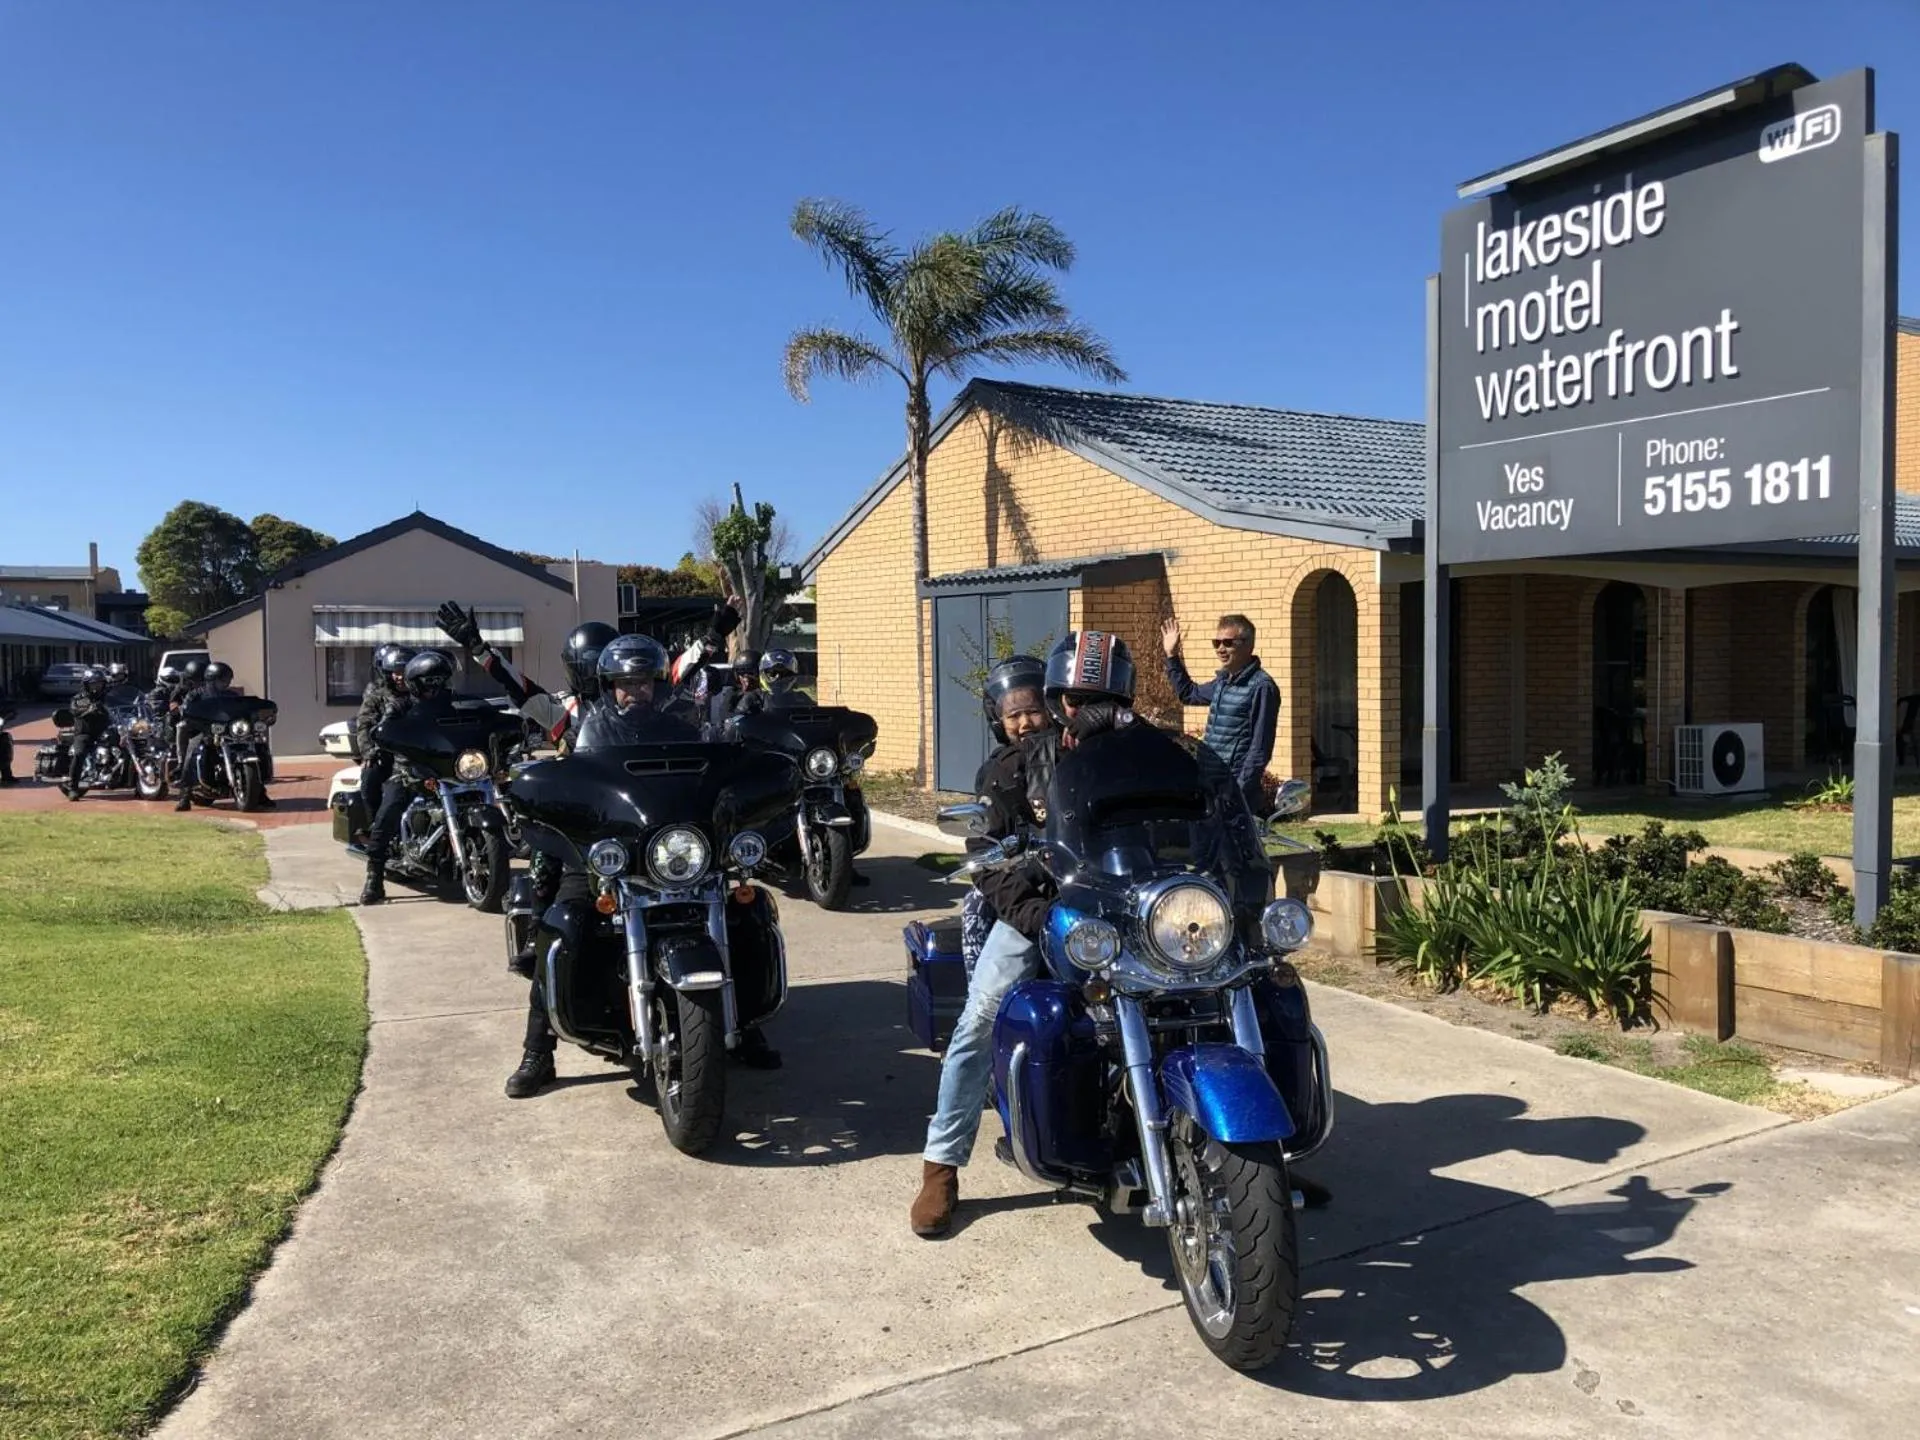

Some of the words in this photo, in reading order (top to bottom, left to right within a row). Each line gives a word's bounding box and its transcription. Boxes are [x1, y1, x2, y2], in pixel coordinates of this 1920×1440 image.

[1476, 172, 1665, 283] lakeside
[1476, 259, 1602, 352] motel
[1475, 308, 1739, 420] waterfront
[1504, 462, 1545, 494] Yes
[1645, 437, 1726, 467] Phone:
[1476, 498, 1574, 531] Vacancy
[1644, 468, 1731, 516] 5155
[1744, 455, 1832, 505] 1811
